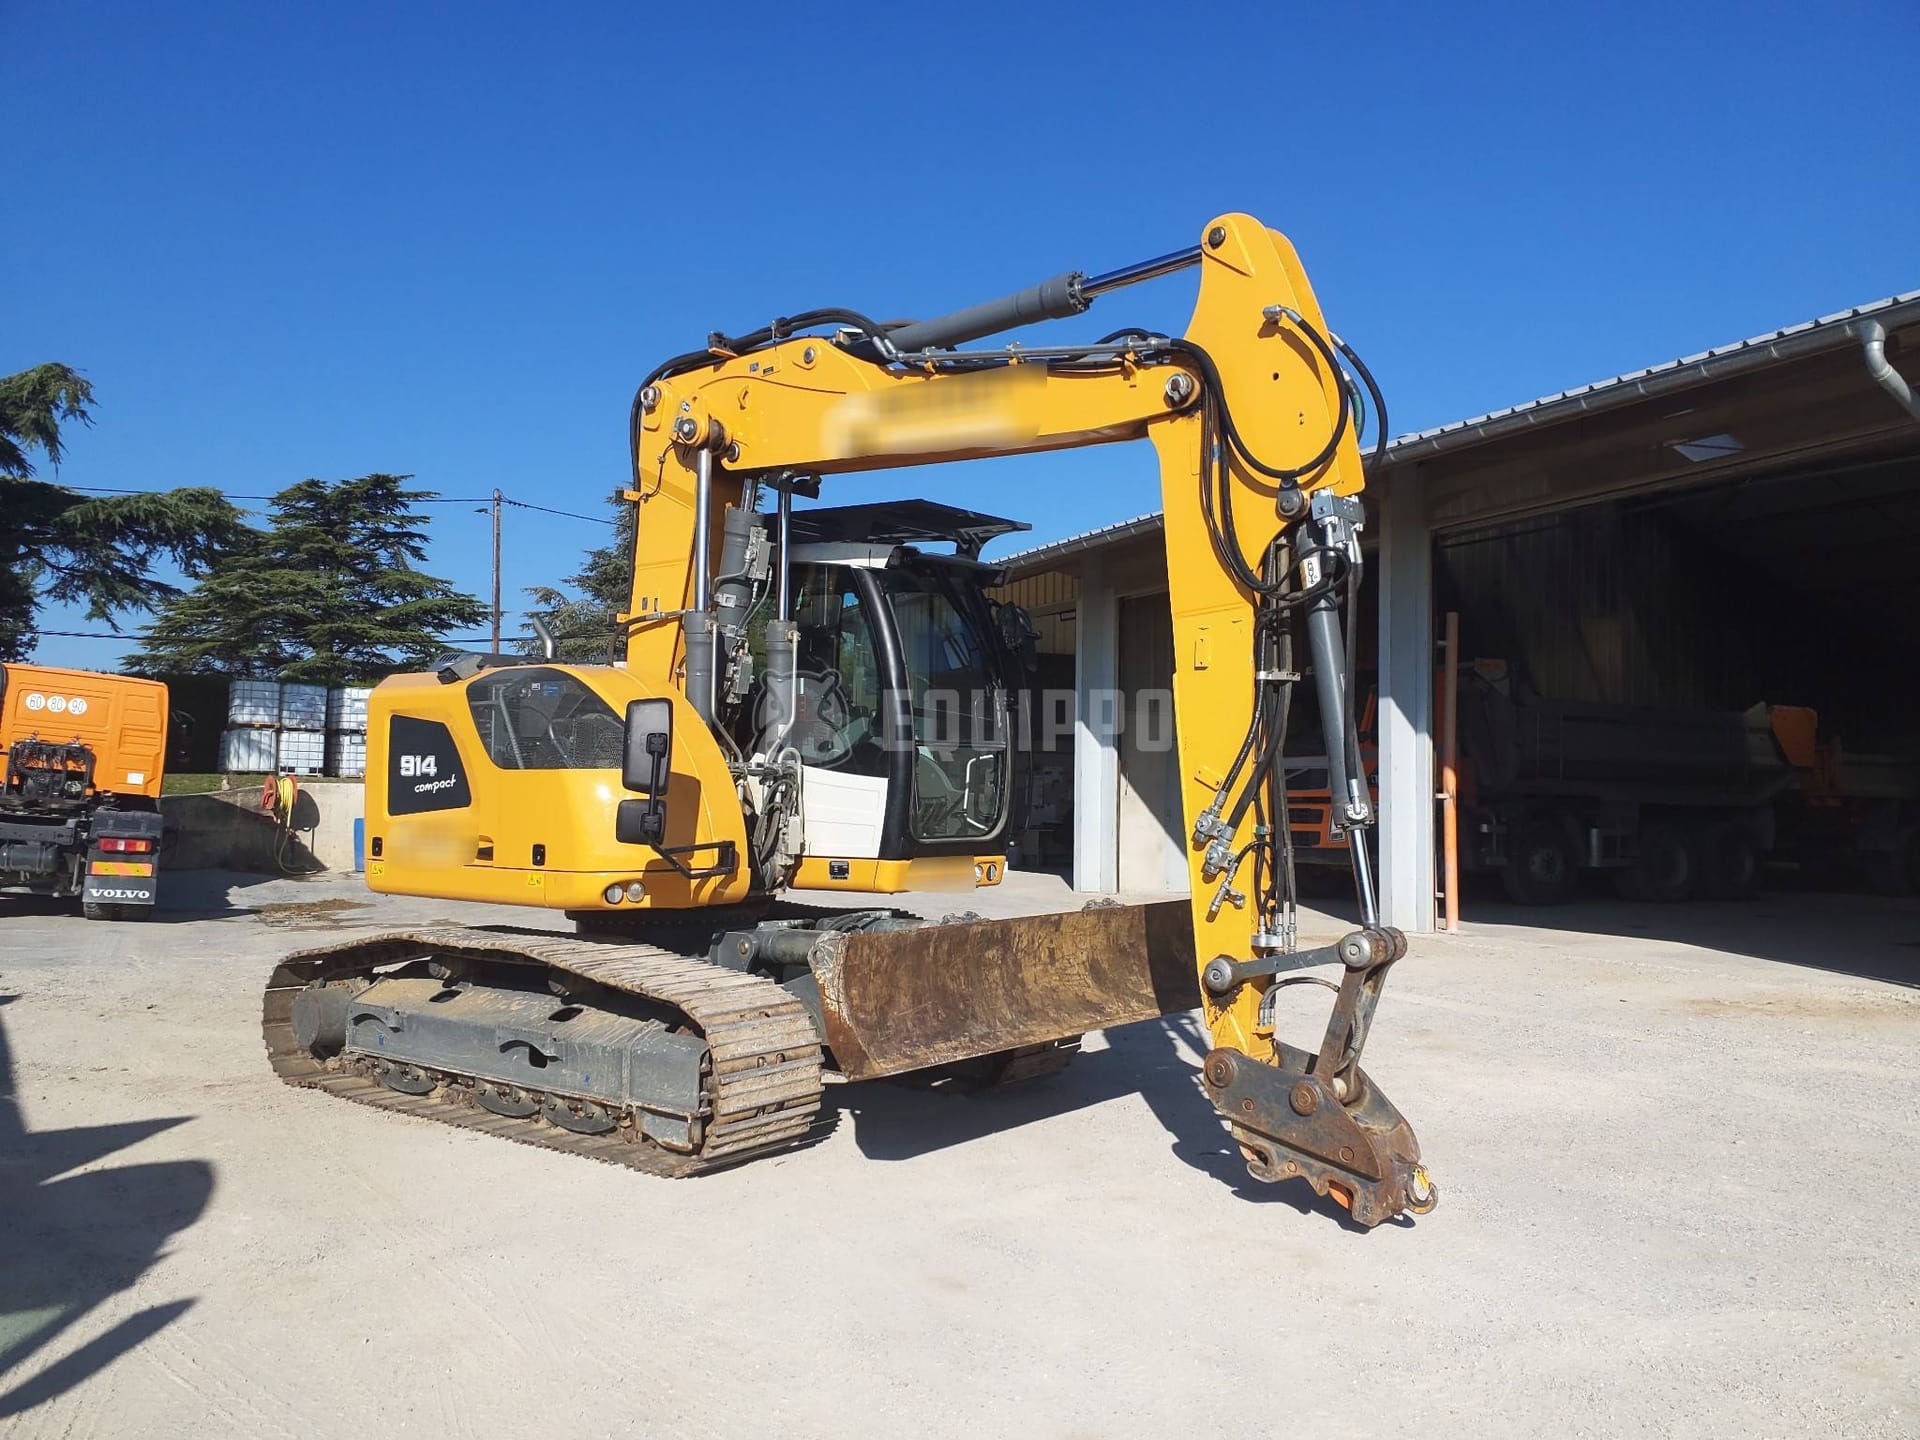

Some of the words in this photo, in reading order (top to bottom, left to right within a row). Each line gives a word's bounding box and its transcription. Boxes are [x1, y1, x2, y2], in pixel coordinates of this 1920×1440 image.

[30, 695, 42, 708] 60
[51, 698, 62, 710] 80
[72, 700, 84, 712] 90
[400, 755, 437, 776] 914
[414, 774, 456, 793] compact
[89, 888, 150, 899] VOLVO
